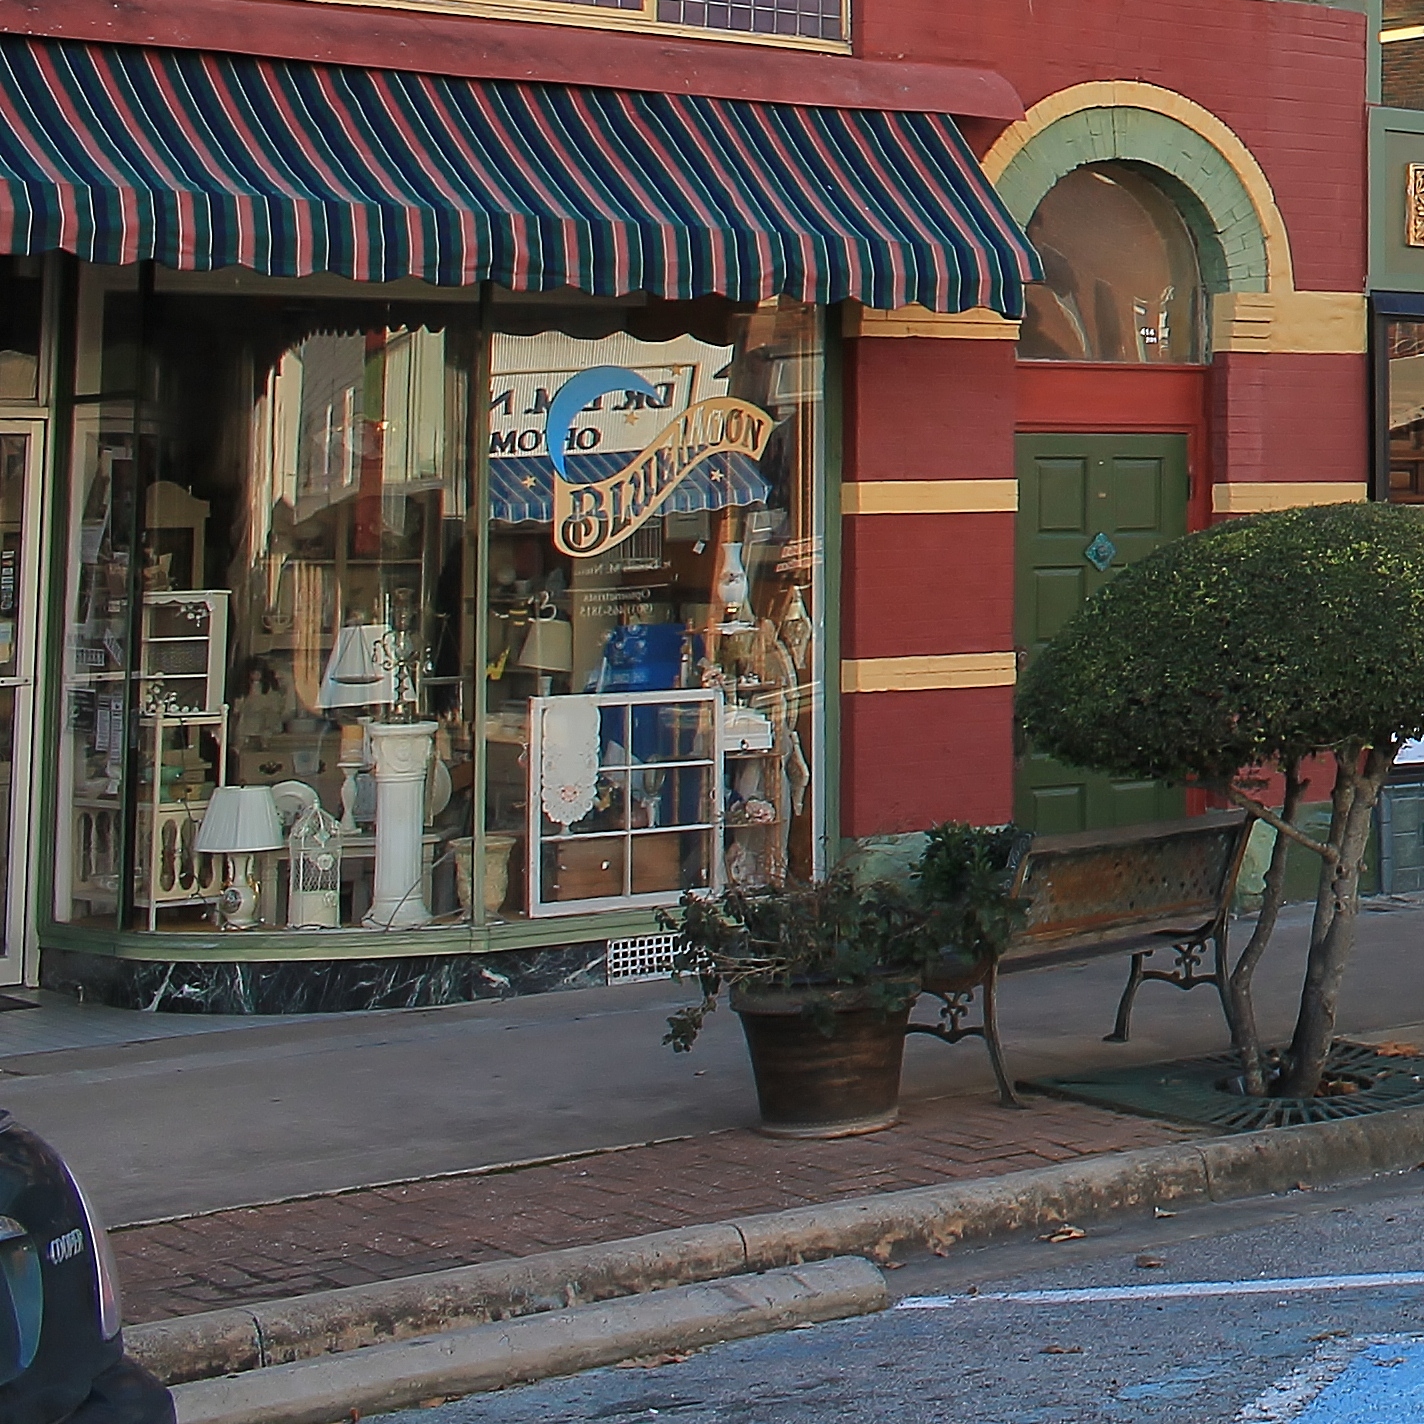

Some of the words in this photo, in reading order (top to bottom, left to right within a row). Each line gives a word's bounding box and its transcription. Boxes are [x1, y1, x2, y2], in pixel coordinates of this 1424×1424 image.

[562, 444, 679, 551] BLUE
[676, 406, 765, 465] MOON
[51, 1228, 84, 1265] COOPER
